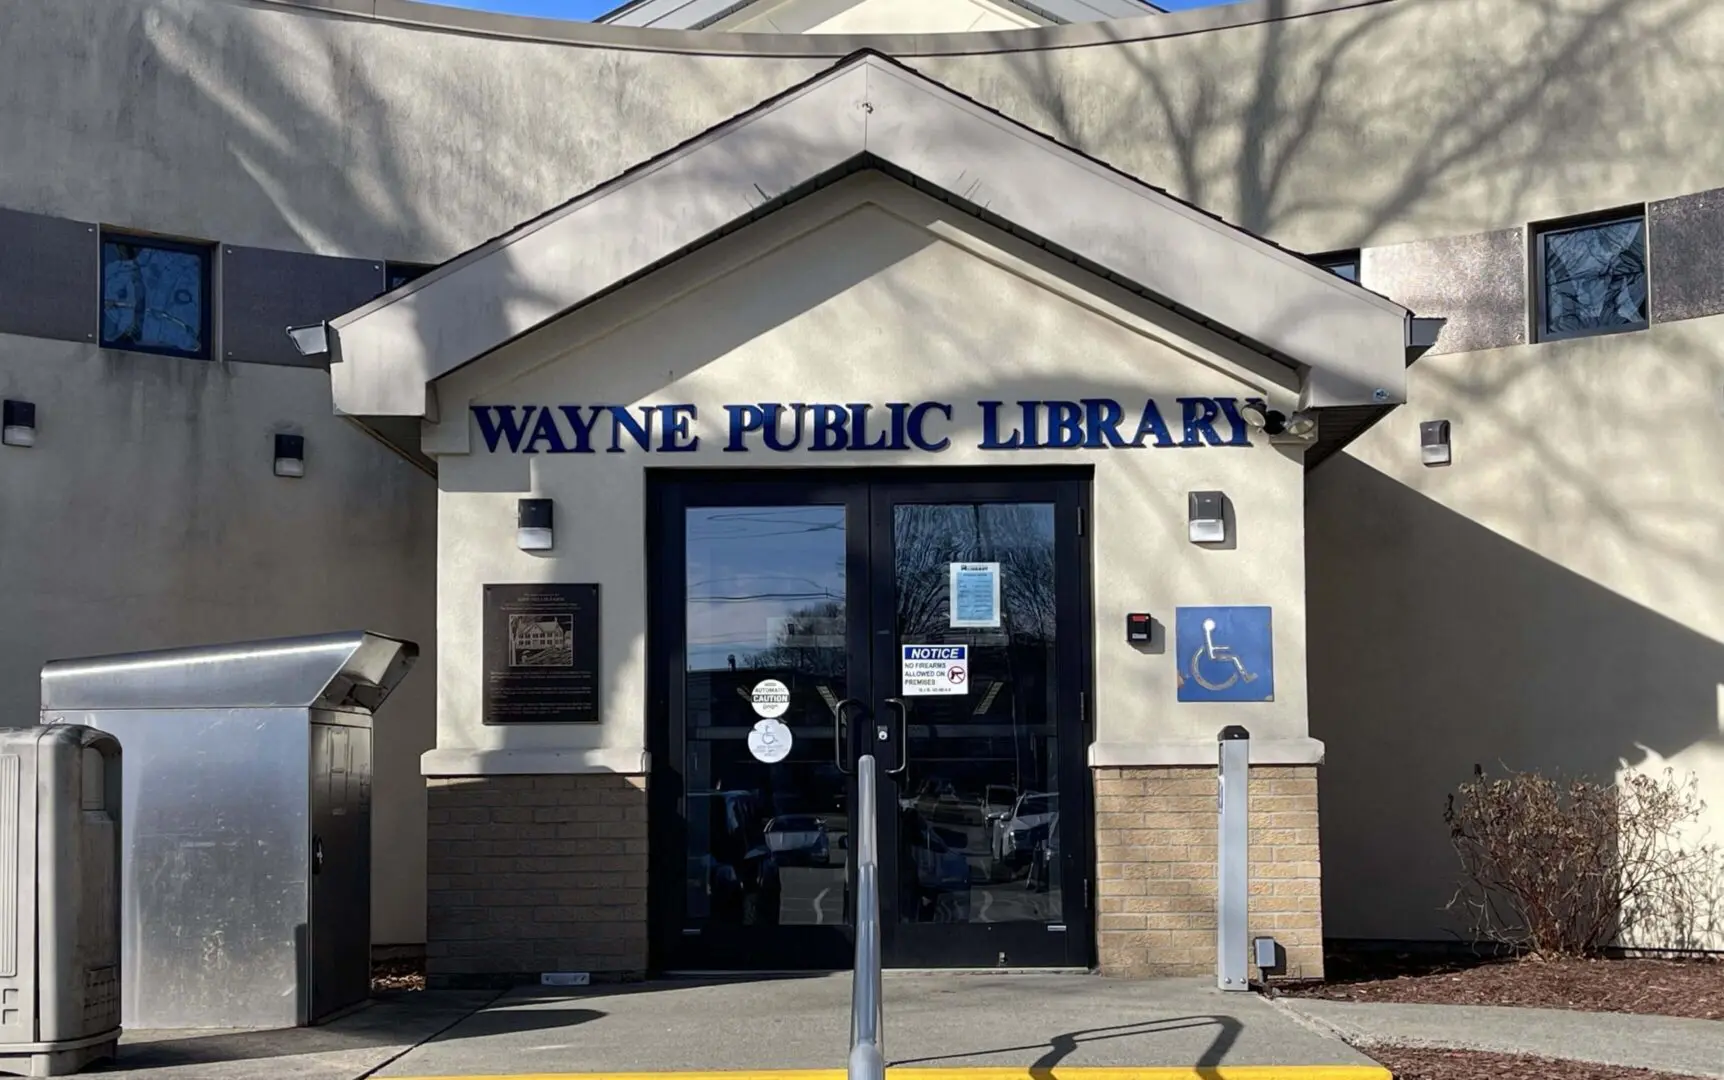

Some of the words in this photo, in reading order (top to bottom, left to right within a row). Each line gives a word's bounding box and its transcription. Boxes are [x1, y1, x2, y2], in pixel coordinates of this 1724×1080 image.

[469, 404, 699, 453] WAYNE
[722, 401, 952, 452] PUBLIC
[977, 397, 1266, 450] LIBRARY
[911, 648, 959, 659] NOTICE
